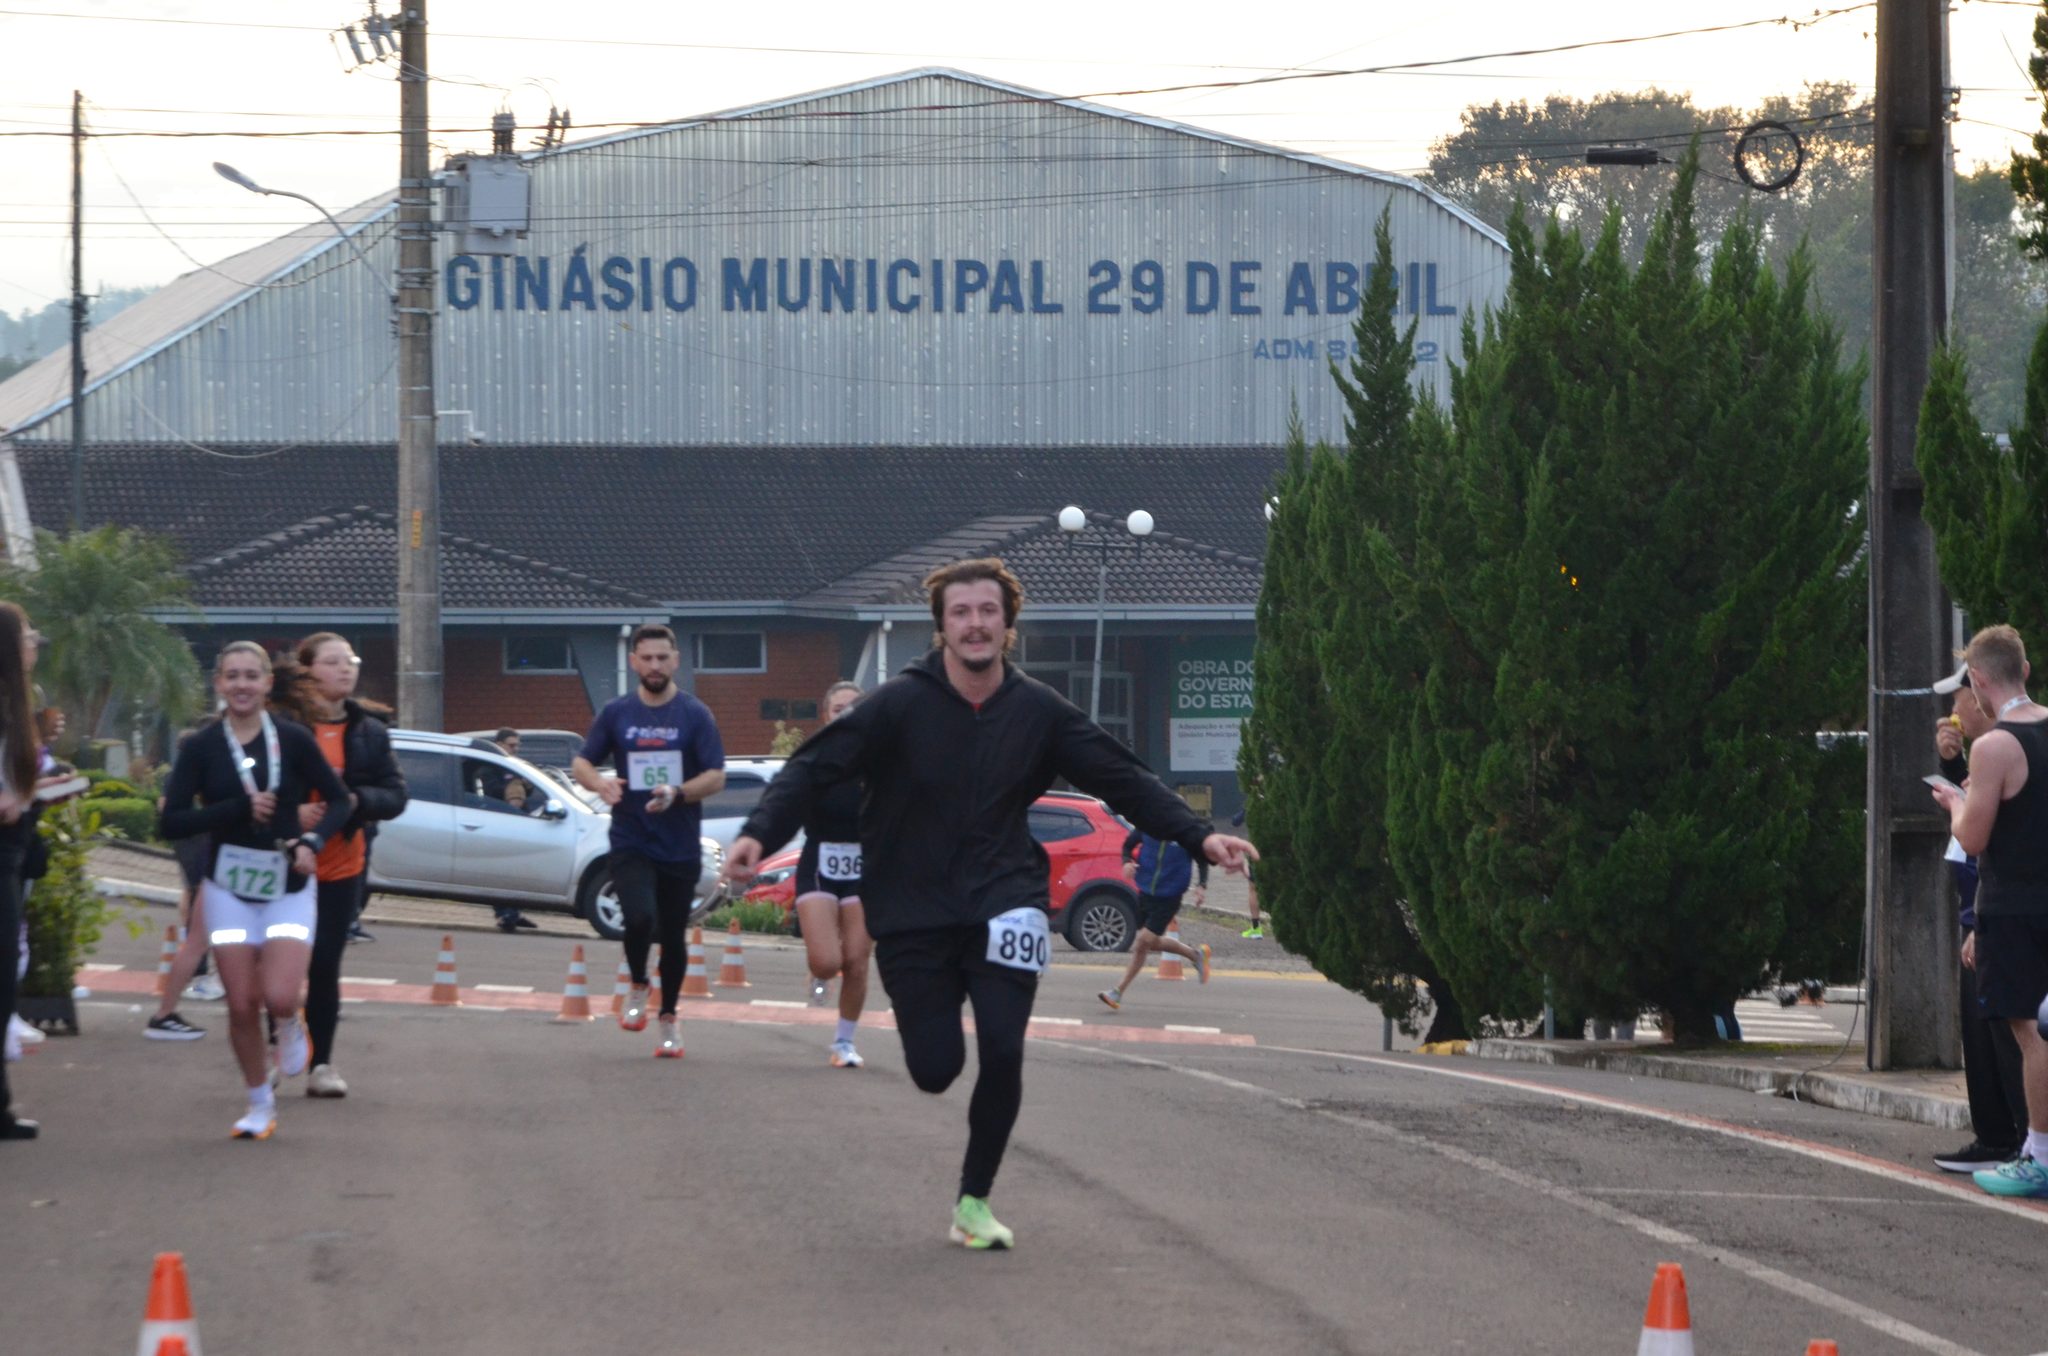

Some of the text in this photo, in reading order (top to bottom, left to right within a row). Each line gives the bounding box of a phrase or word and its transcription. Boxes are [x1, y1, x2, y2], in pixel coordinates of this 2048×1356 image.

[446, 241, 1458, 316] GINÁSIO MUNICIPAL 29 DE ABIL
[1178, 660, 1230, 675] OBRA
[1178, 677, 1254, 692] GOVERN
[1178, 693, 1254, 709] DO ESTA
[643, 766, 669, 787] 65
[827, 855, 863, 876] 936
[227, 866, 276, 896] 172
[1000, 928, 1046, 967] 890
